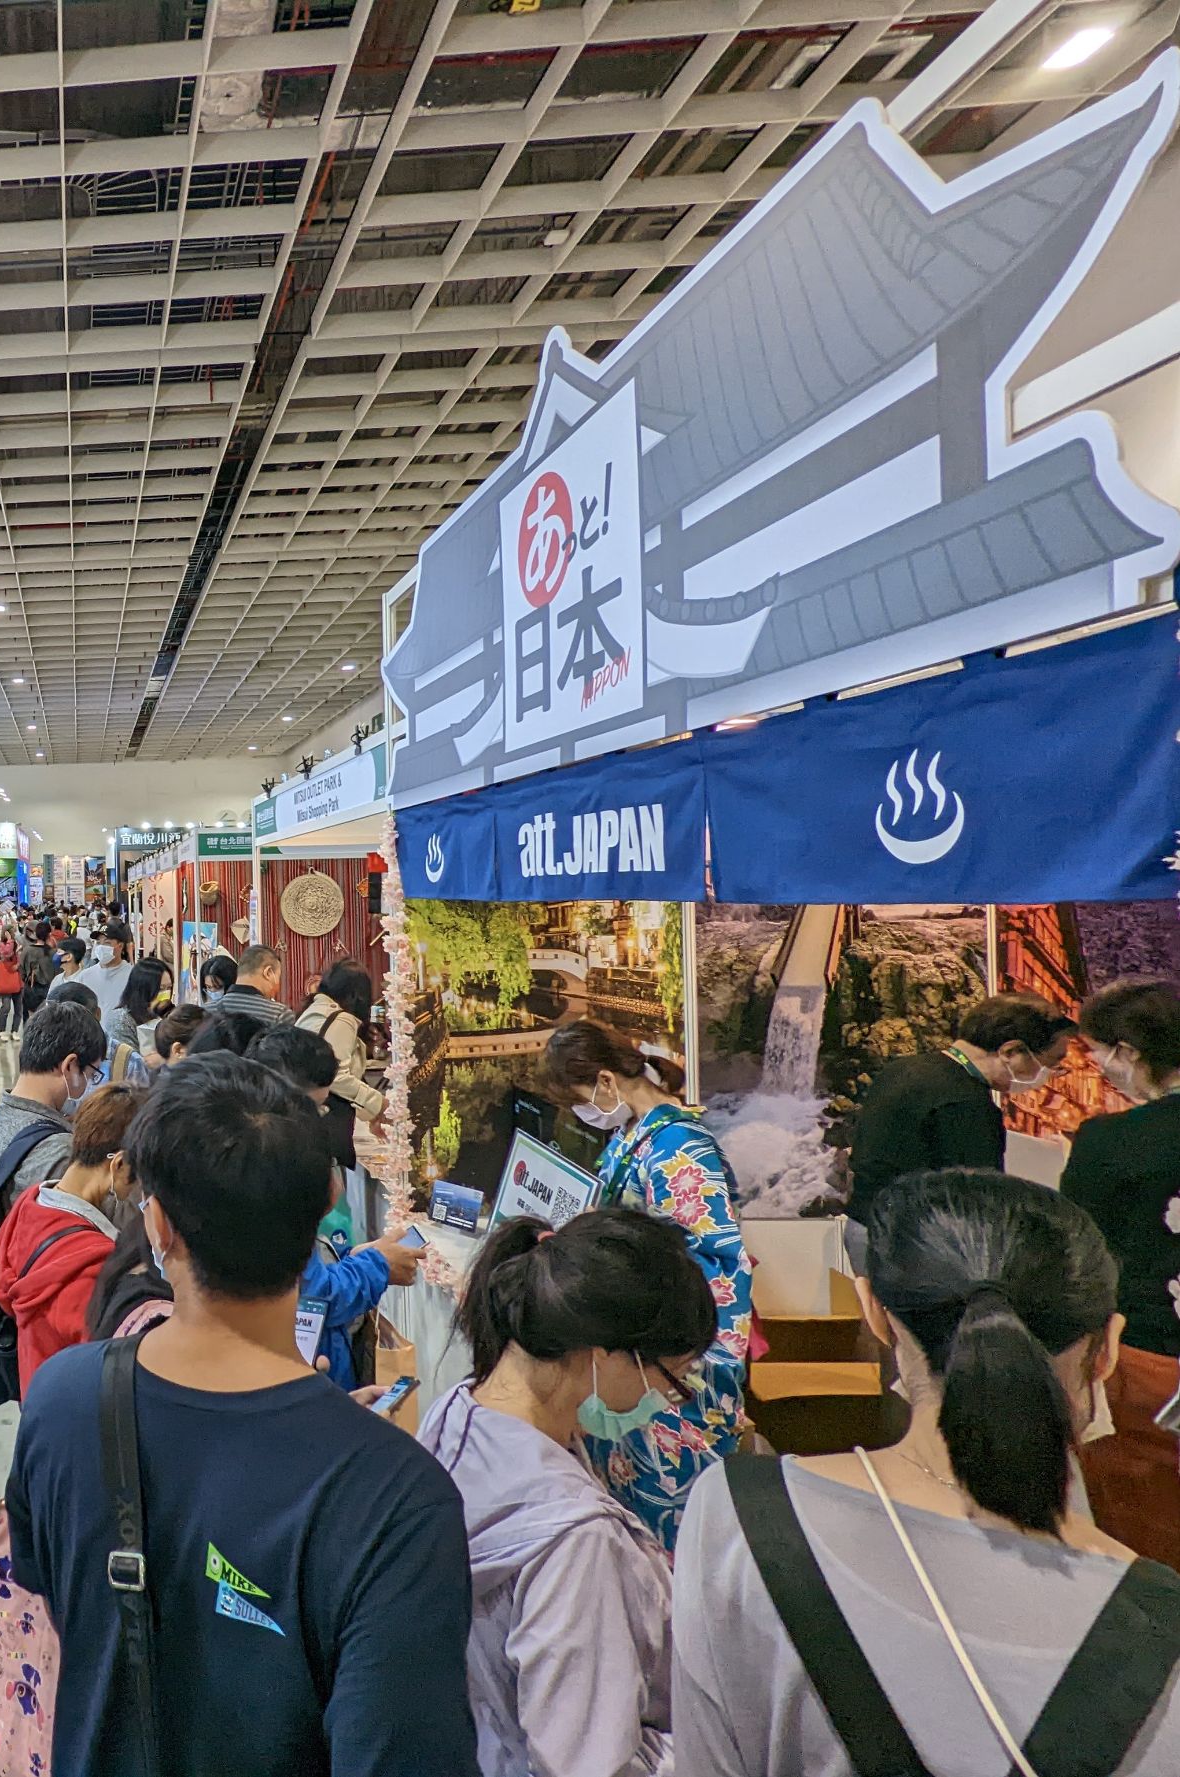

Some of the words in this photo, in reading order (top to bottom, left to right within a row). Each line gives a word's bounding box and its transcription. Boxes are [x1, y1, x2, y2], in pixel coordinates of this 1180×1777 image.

[515, 564, 626, 723] 日本
[580, 646, 631, 712] NIPPON
[307, 781, 324, 800] OUTLET
[324, 776, 337, 793] PARK
[309, 800, 328, 819] Shopping
[328, 796, 340, 814] Park
[517, 803, 666, 878] att.JAPAN
[221, 1560, 257, 1592] MIKE
[235, 1600, 274, 1627] SULLEY
